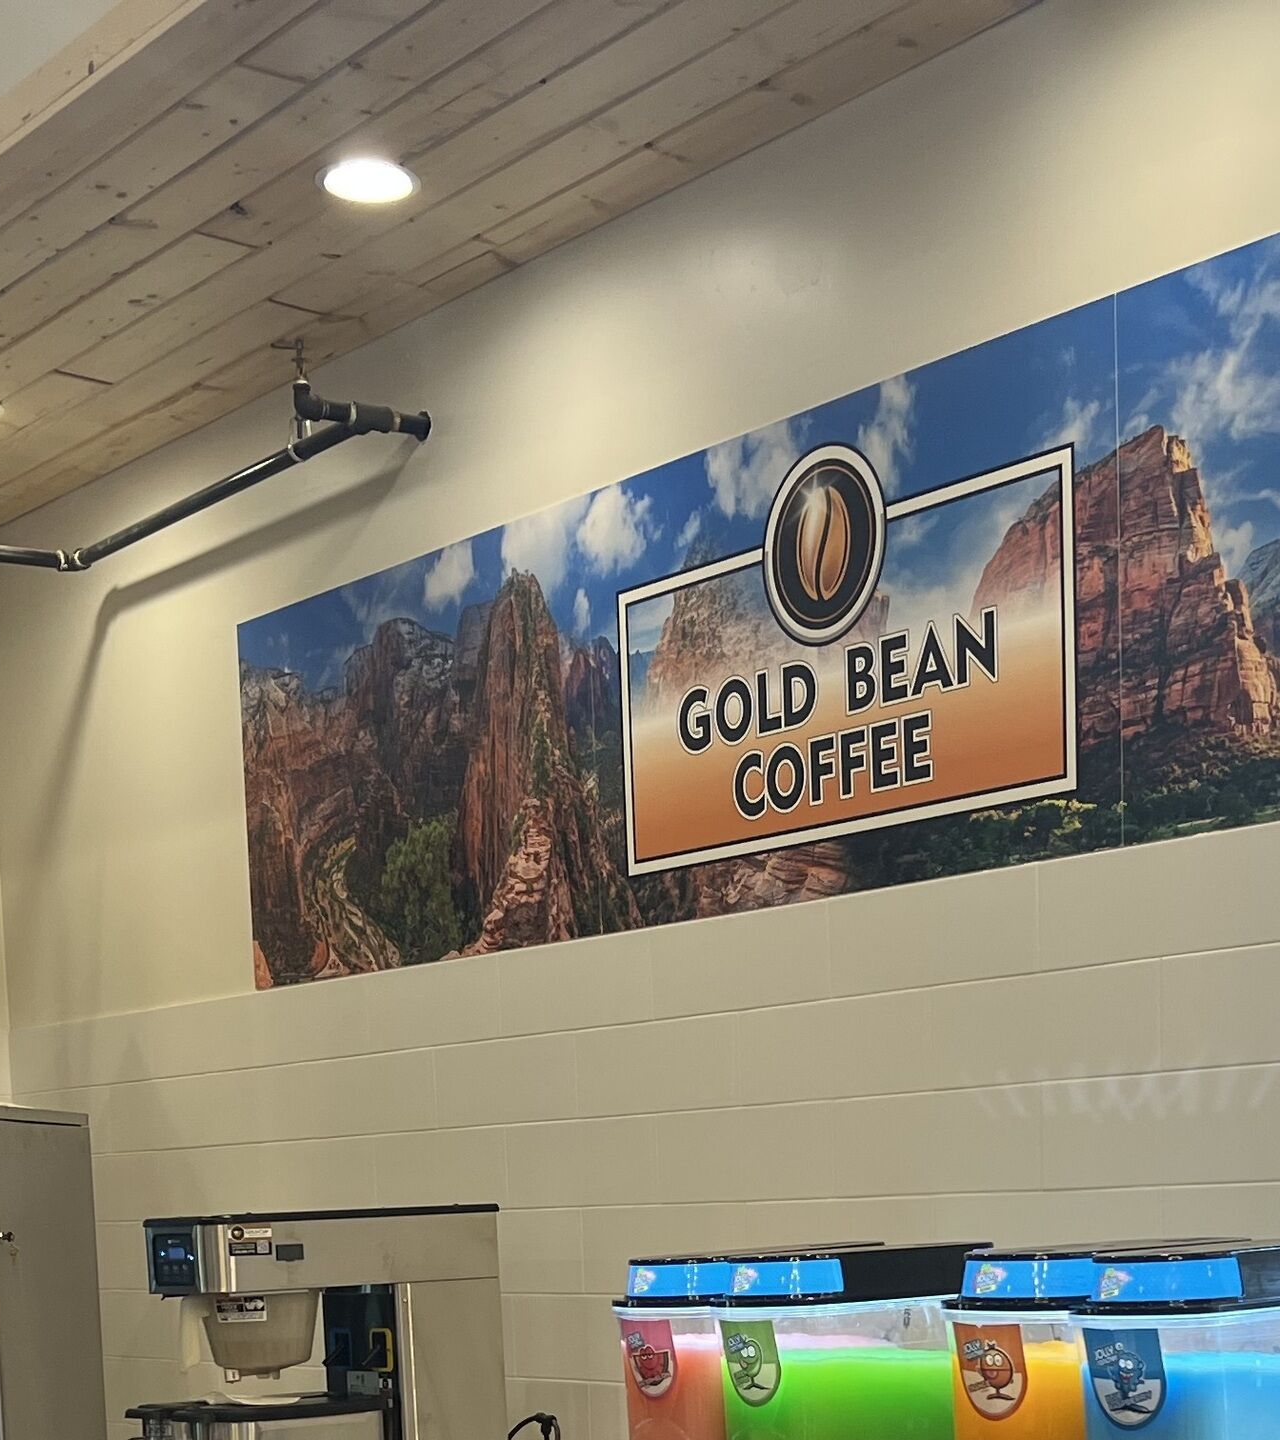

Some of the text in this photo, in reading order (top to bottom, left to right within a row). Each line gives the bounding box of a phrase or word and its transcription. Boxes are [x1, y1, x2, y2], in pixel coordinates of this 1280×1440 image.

[678, 605, 998, 755] GOLD BEAN
[733, 710, 933, 820] COFFEE
[1095, 1344, 1115, 1361] JOLLY
